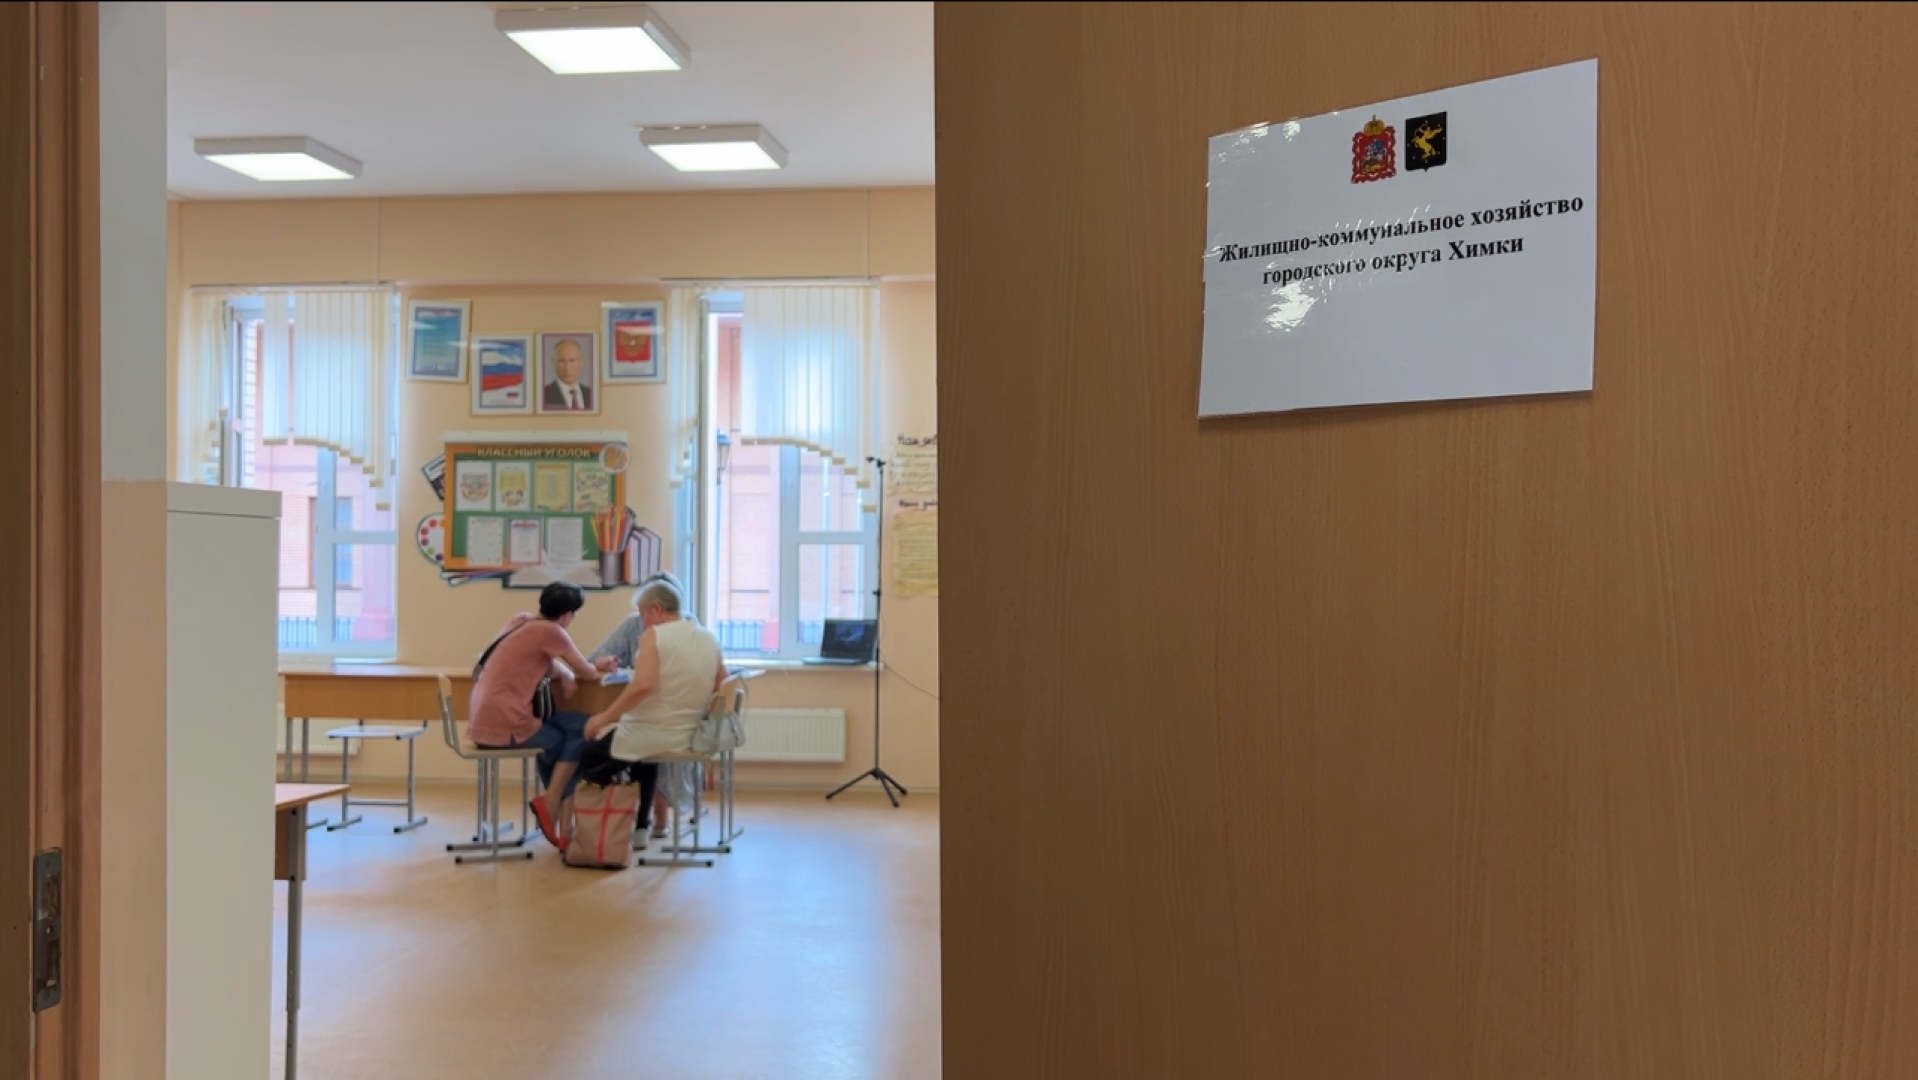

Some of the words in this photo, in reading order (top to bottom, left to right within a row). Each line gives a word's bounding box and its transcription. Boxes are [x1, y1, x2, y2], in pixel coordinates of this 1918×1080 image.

[1219, 215, 1465, 262] Жилищно-коммунальное
[1471, 196, 1584, 226] хозяйство
[1263, 258, 1366, 286] городского
[1372, 248, 1441, 272] округа
[1449, 236, 1524, 261] Химки
[477, 447, 542, 458] КЛАССНЫЙ
[544, 447, 591, 458] УГОЛОК
